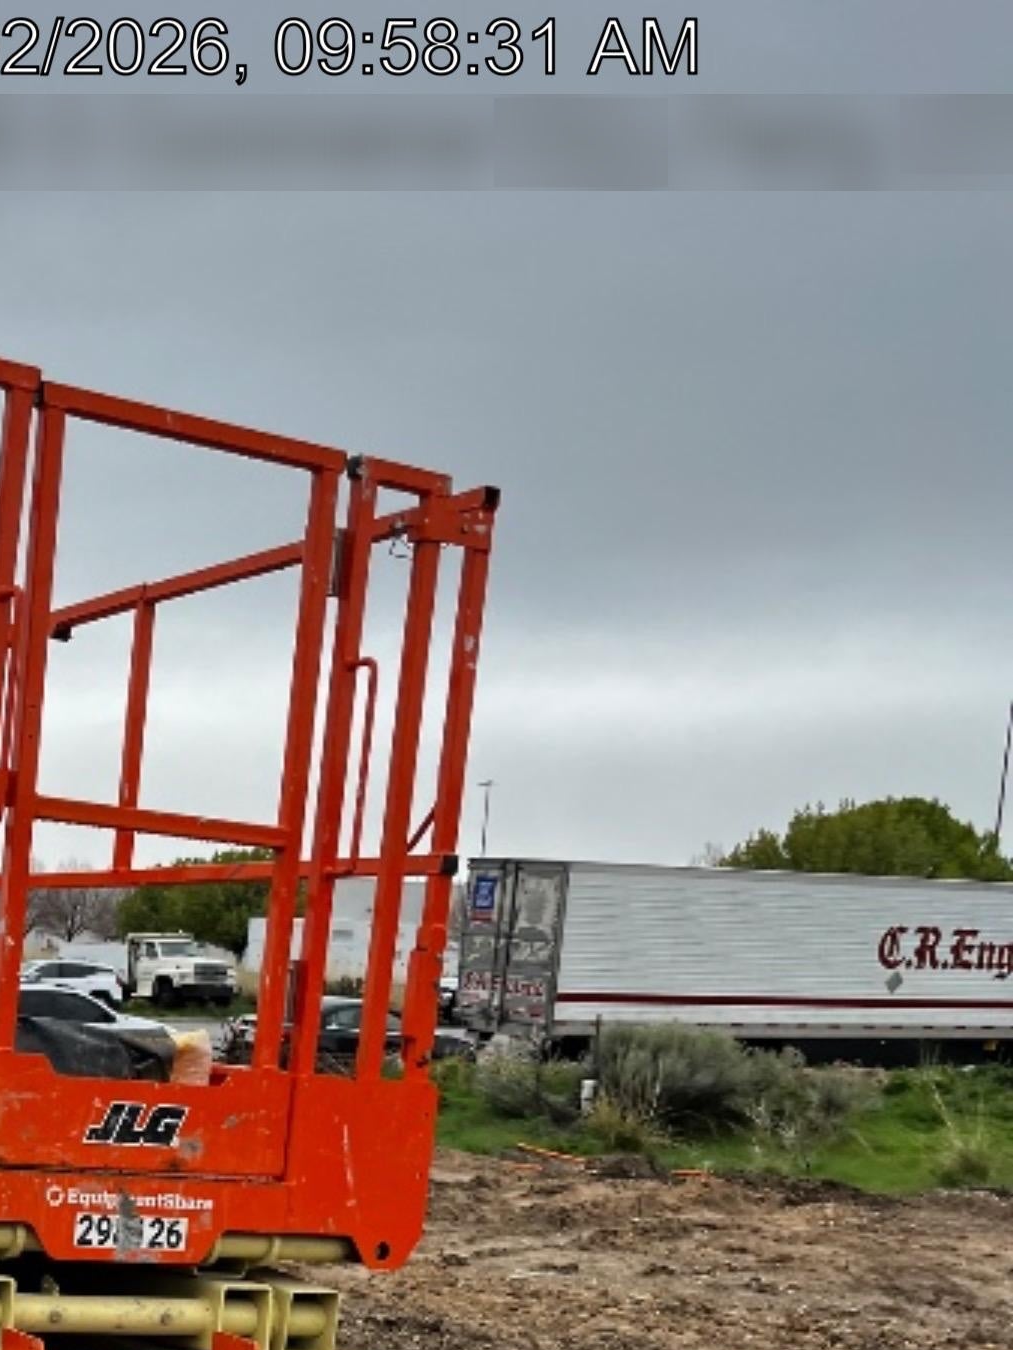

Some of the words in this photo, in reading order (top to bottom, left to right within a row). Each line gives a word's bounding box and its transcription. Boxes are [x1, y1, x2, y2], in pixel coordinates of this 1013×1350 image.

[83, 1100, 189, 1147] JLG
[67, 1187, 214, 1211] EquipentShare
[76, 1215, 183, 1248] 2926
